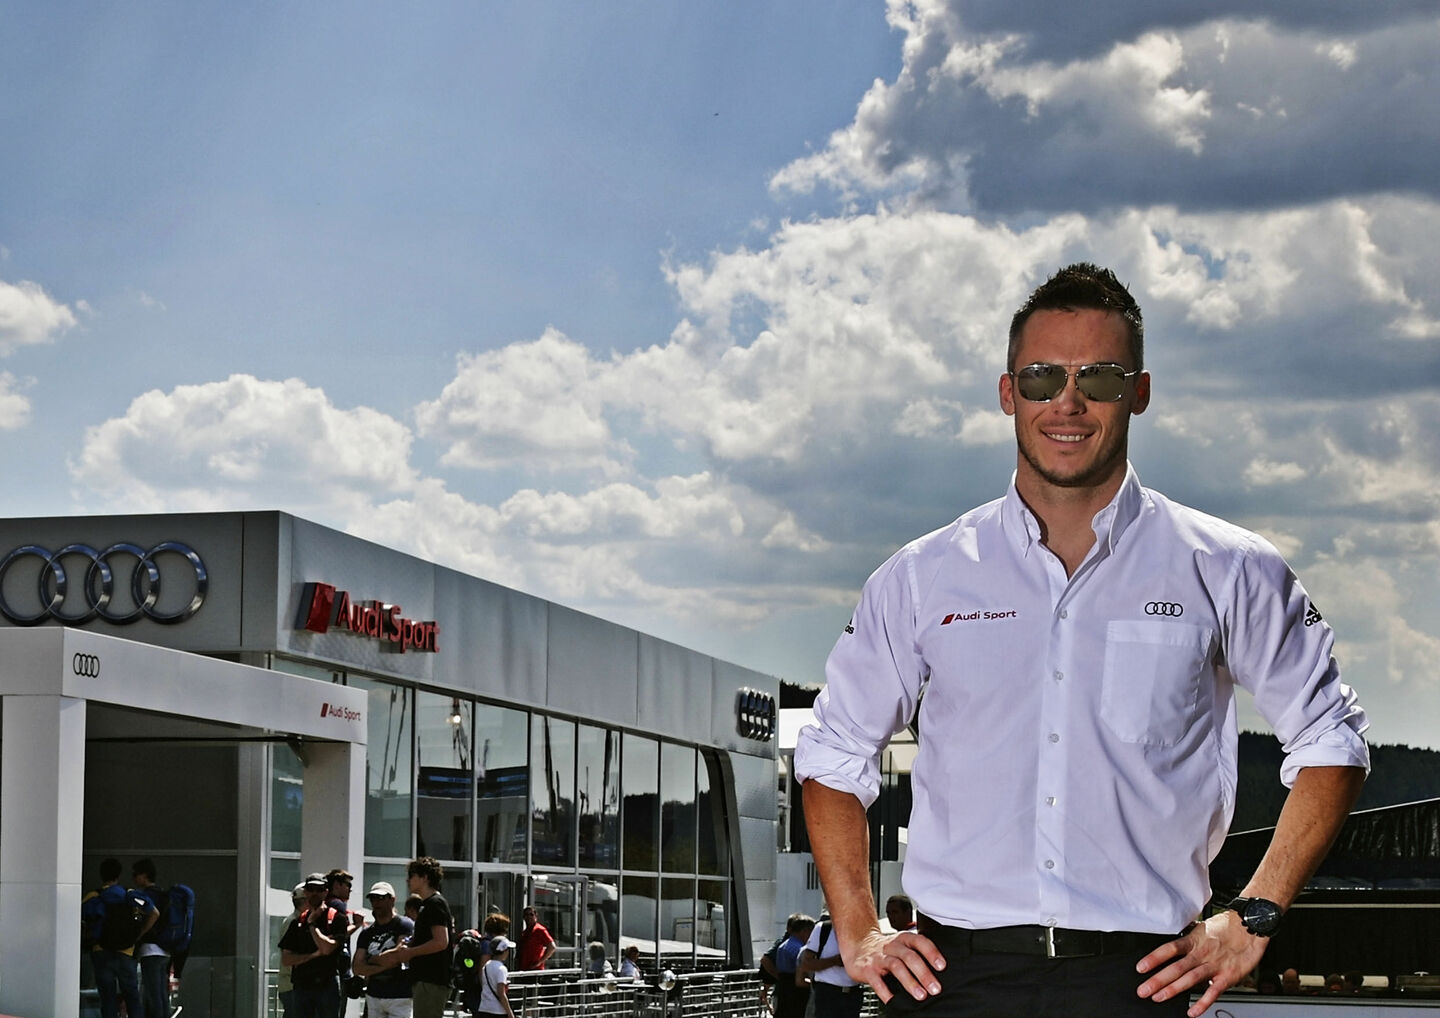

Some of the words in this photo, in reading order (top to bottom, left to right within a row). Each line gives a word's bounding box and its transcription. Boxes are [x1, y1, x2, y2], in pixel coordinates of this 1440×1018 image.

[335, 591, 384, 638] Audi
[389, 604, 440, 654] Sport
[954, 610, 980, 621] Audi
[983, 610, 1016, 620] Sport
[329, 704, 343, 718] Audi
[344, 707, 361, 721] Sport
